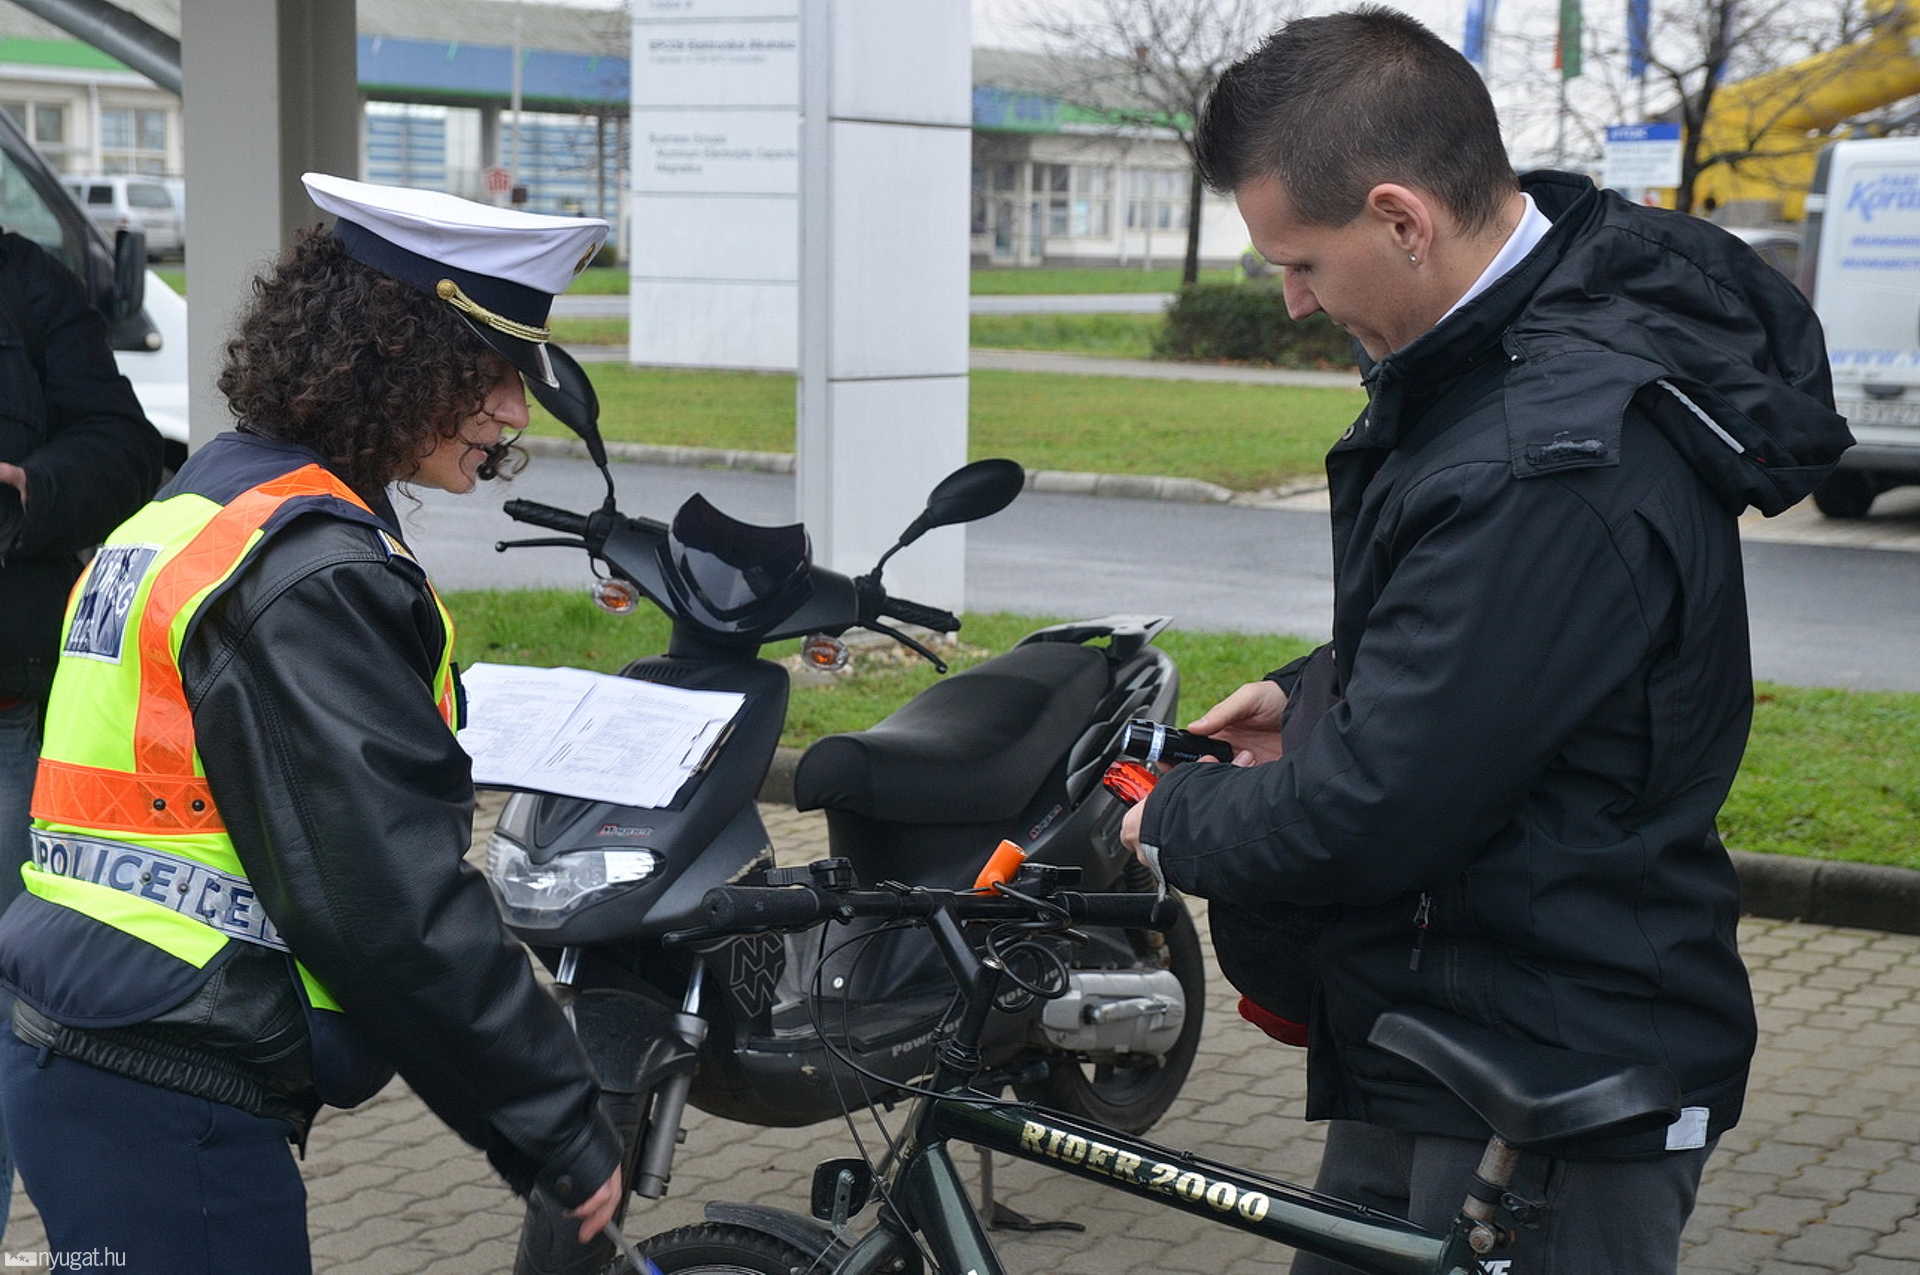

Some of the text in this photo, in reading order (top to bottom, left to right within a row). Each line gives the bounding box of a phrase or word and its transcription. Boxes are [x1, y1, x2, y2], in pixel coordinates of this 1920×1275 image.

[37, 840, 177, 903] POLICE
[1020, 1120, 1271, 1224] RIDER 2000
